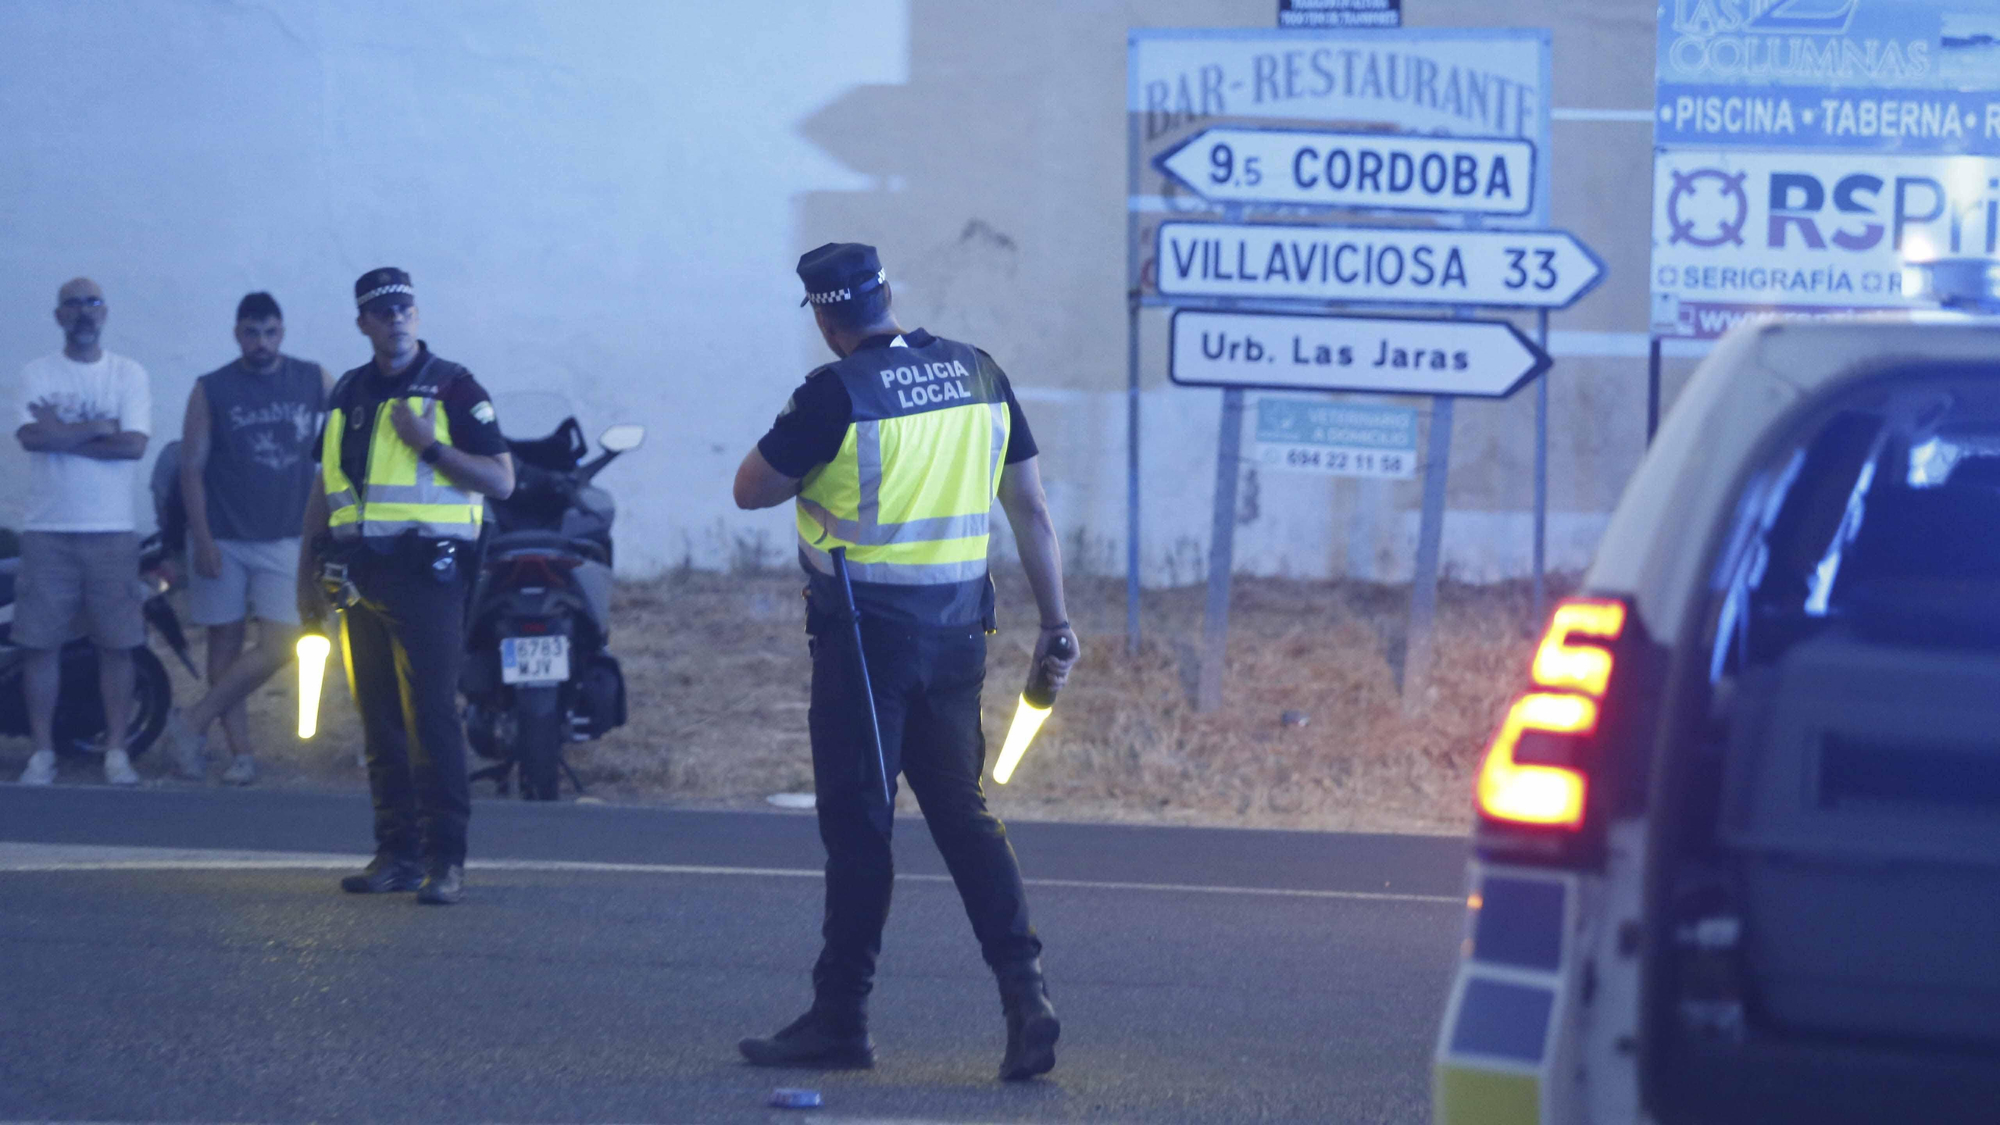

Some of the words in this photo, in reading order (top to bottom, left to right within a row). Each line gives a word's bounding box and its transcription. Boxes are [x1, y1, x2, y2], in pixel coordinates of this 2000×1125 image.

[1669, 36, 1929, 79] COLUMNAS
[1145, 49, 1535, 142] BAR-RESTAURANTE
[1675, 97, 1795, 134] PISCINA
[1821, 99, 1962, 138] TABERNA
[1292, 147, 1512, 198] CORDOBA
[1170, 238, 1467, 289] VILLAVICIOSA
[1503, 249, 1558, 290] 33
[1683, 264, 1854, 294] SERIGRAFÍA
[1202, 331, 1275, 363] Urb.
[1292, 338, 1353, 366] Las
[1372, 338, 1470, 371] Jaras
[880, 360, 969, 389] POLICIA
[897, 380, 971, 409] LOCAL
[1325, 451, 1349, 470] 22
[1355, 454, 1375, 471] 11
